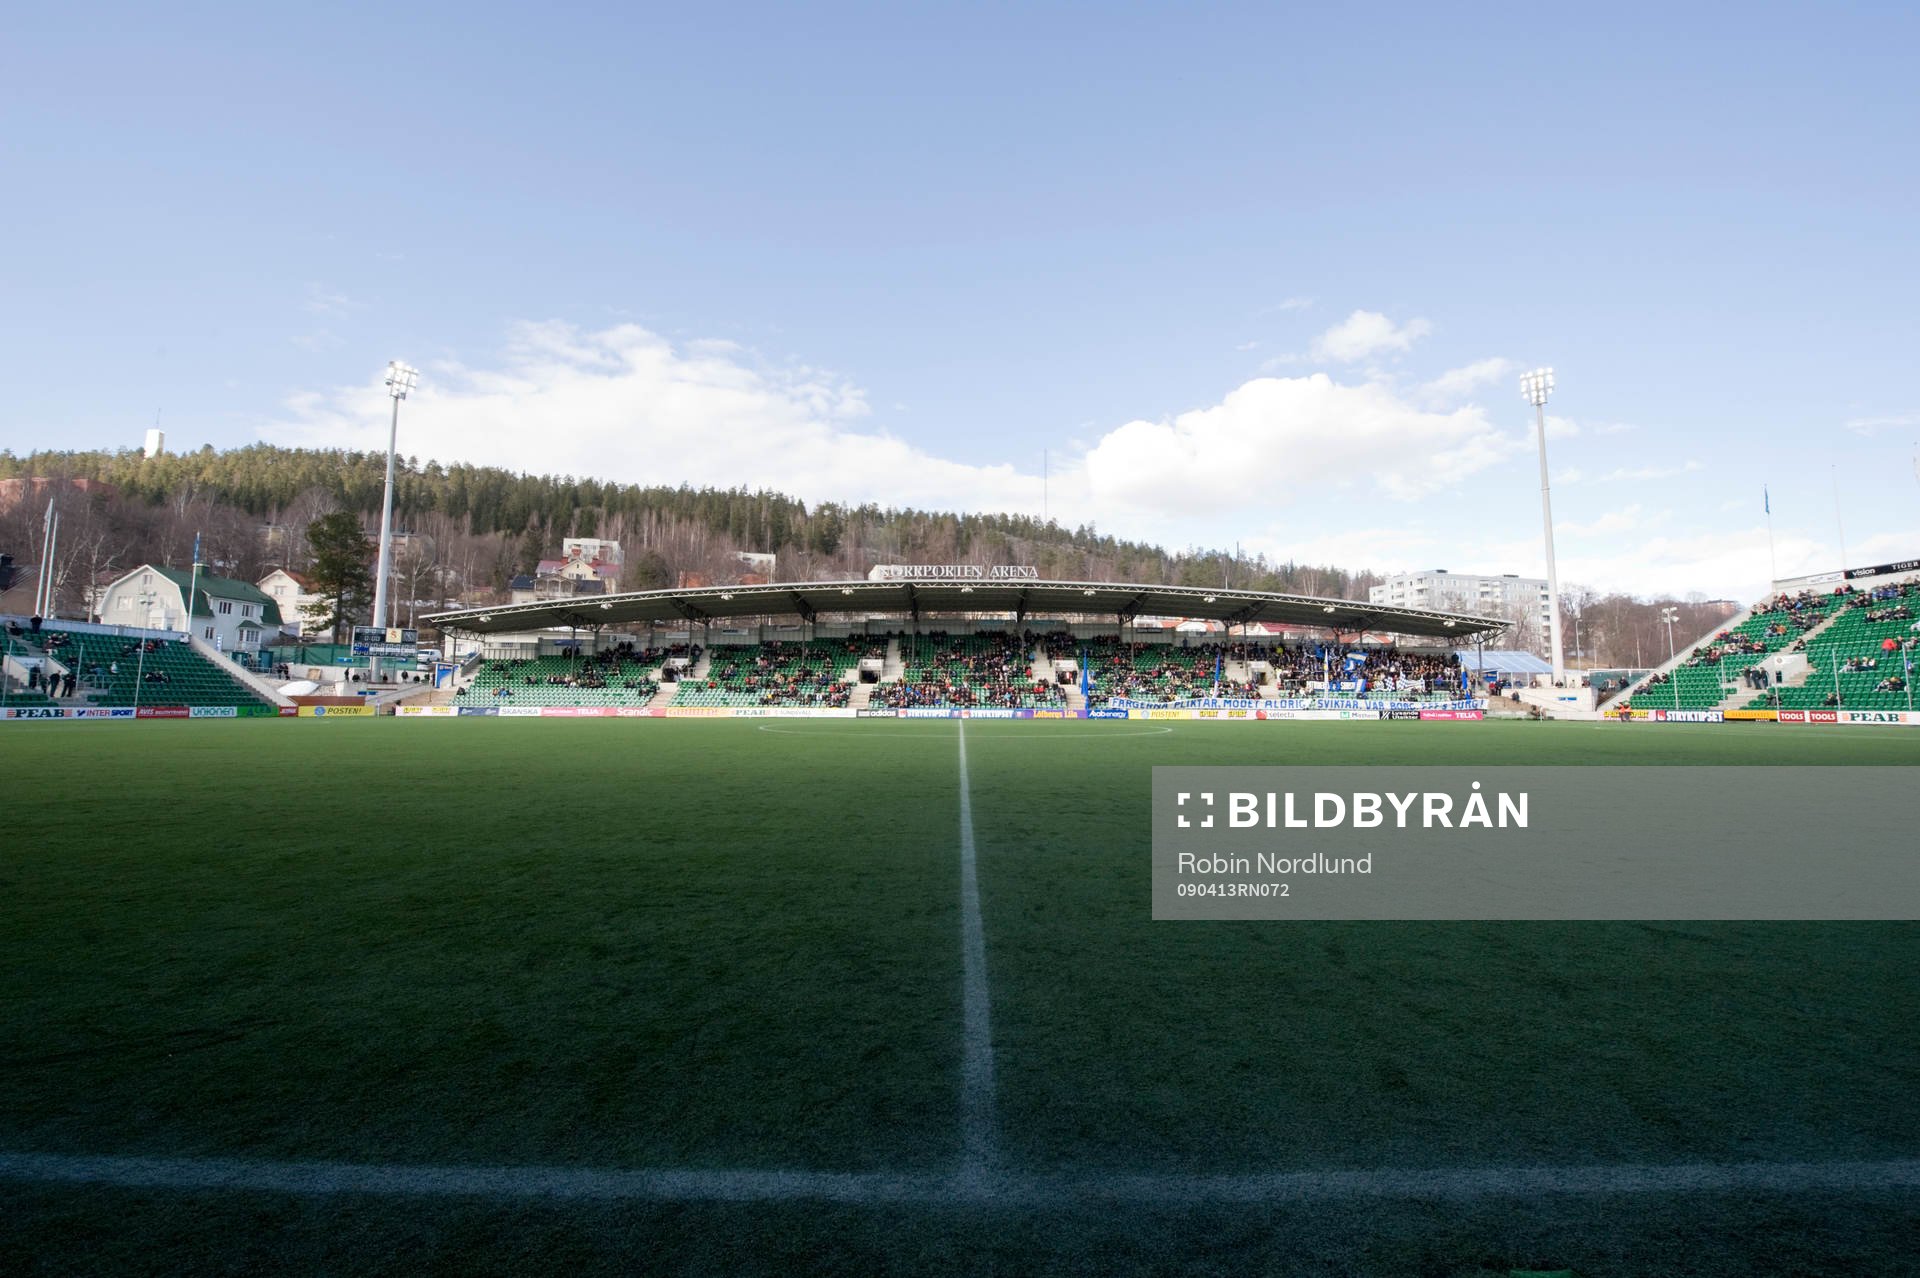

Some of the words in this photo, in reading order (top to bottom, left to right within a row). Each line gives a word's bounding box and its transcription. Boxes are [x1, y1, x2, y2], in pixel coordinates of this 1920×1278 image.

[990, 565, 1039, 578] ARENA
[1852, 568, 1876, 577] vision
[15, 708, 65, 718] PEAB
[327, 707, 362, 715] POSTEN!
[616, 707, 652, 716] Scandic
[870, 708, 897, 717] adidas
[907, 709, 950, 718] STRYKTIPSET
[970, 709, 1014, 718] STRYKTIPSET
[1665, 711, 1724, 722] STRYKTIPSET
[1780, 713, 1804, 721] TOOLS
[1810, 713, 1836, 721] TOOLS
[1850, 713, 1900, 722] PEAB
